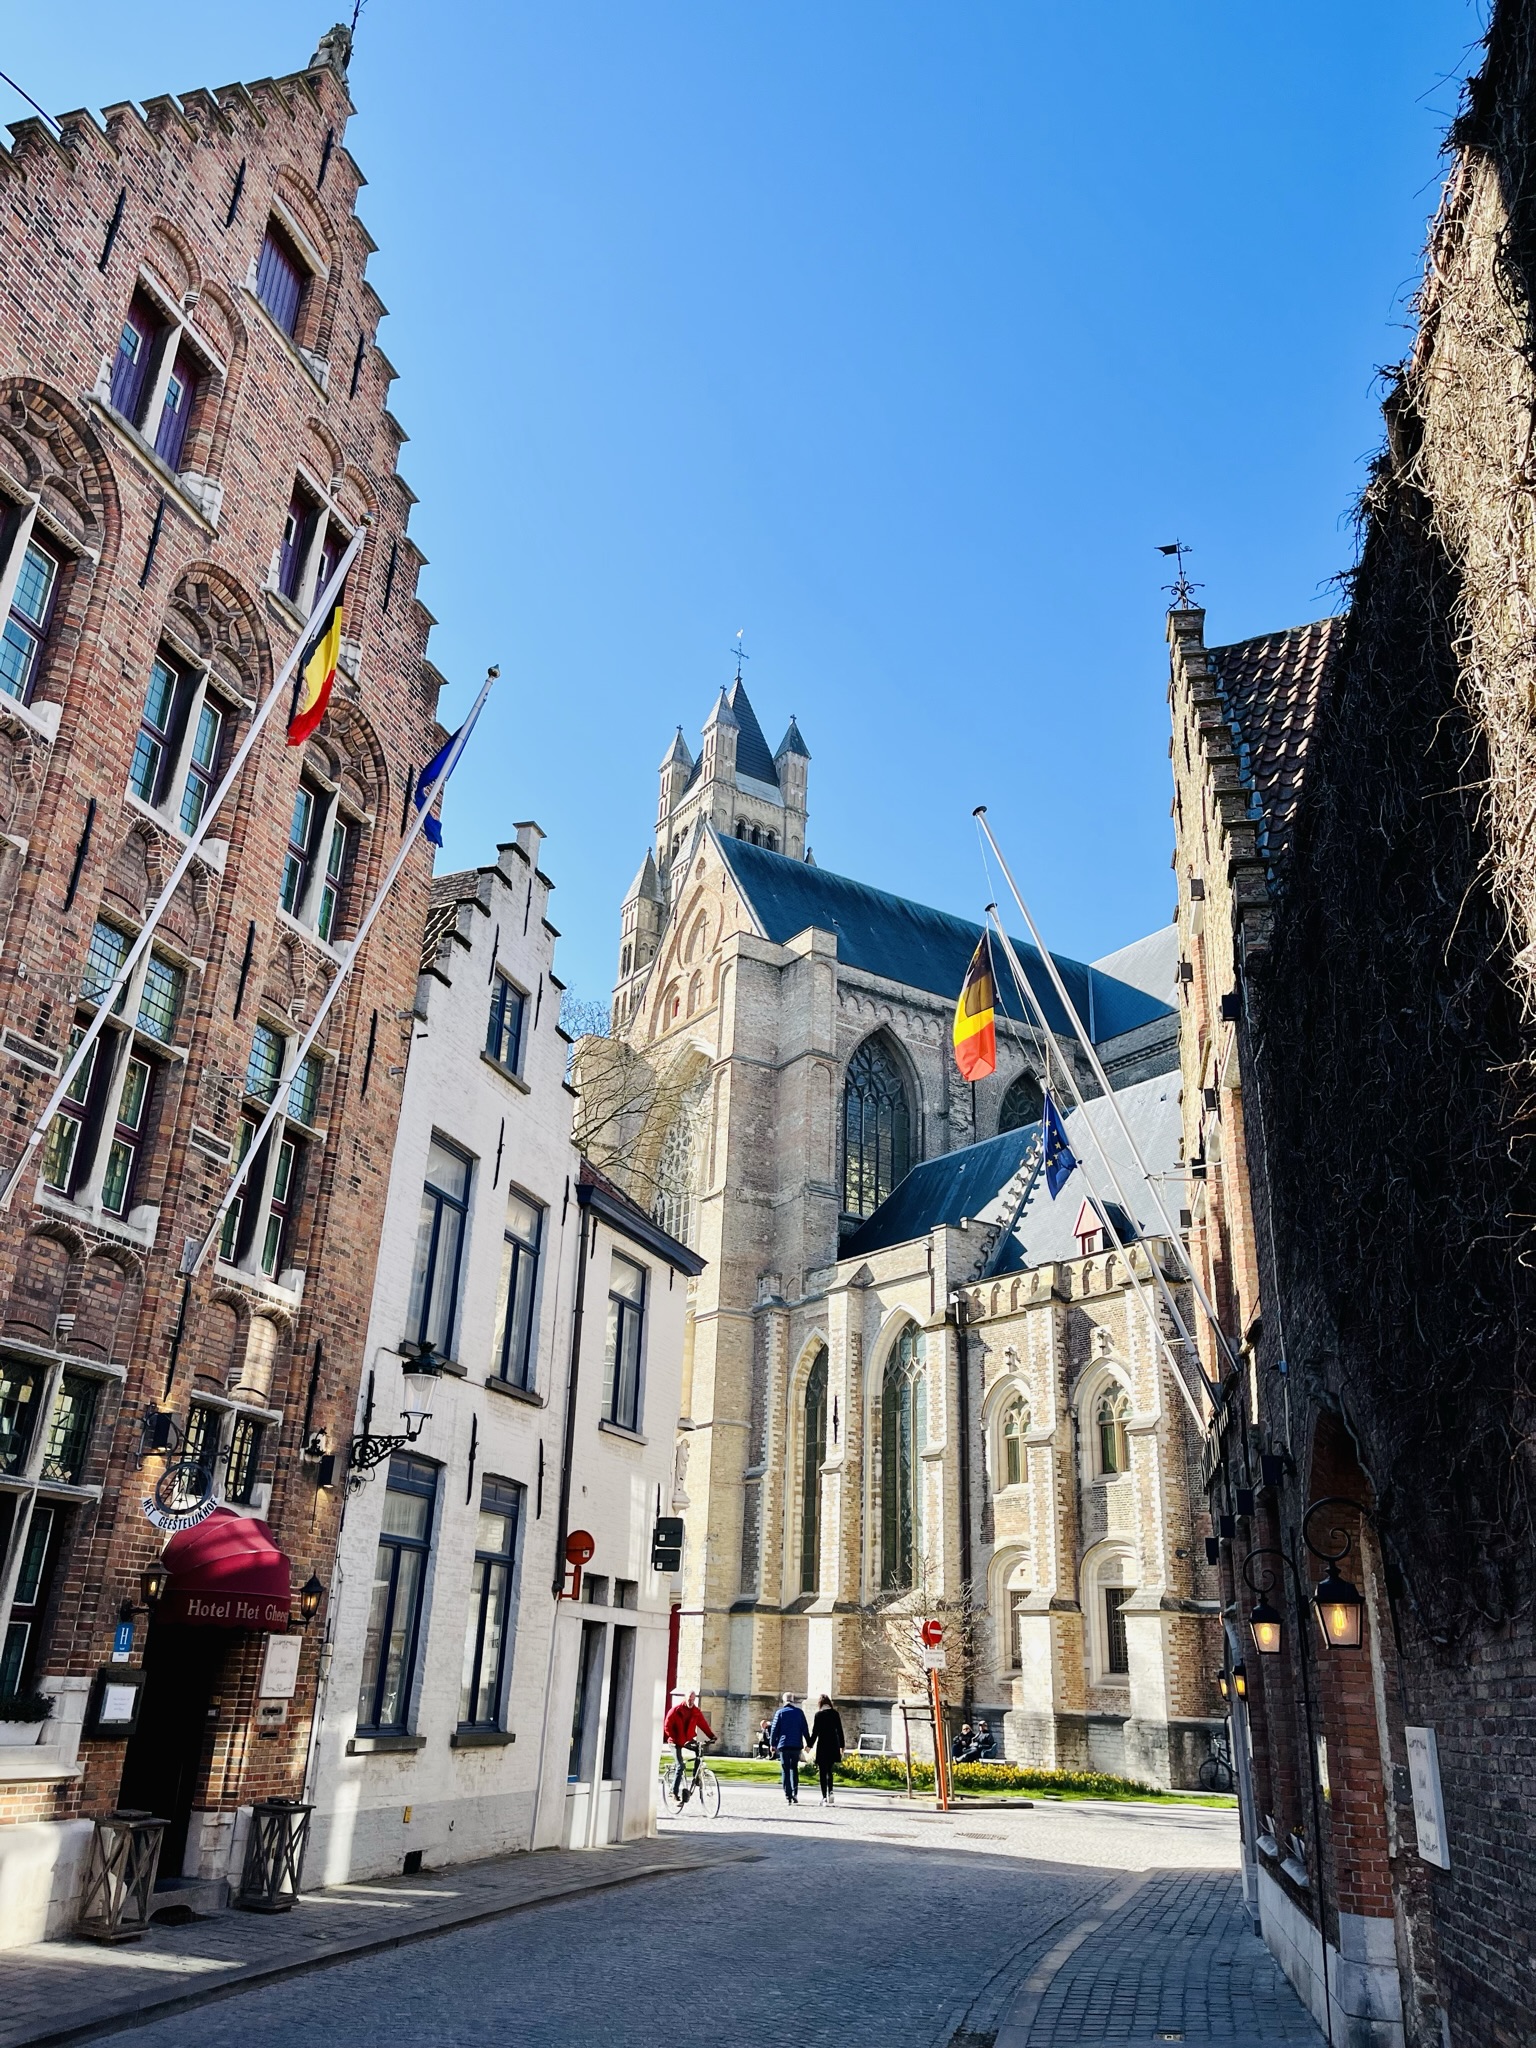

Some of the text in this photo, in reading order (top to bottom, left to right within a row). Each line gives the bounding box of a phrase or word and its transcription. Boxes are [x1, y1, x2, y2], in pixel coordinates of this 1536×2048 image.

[143, 1497, 218, 1530] HET GEESTELIJKHOF
[187, 1599, 231, 1618] Hotel
[235, 1602, 260, 1619] Het
[120, 1627, 129, 1645] H
